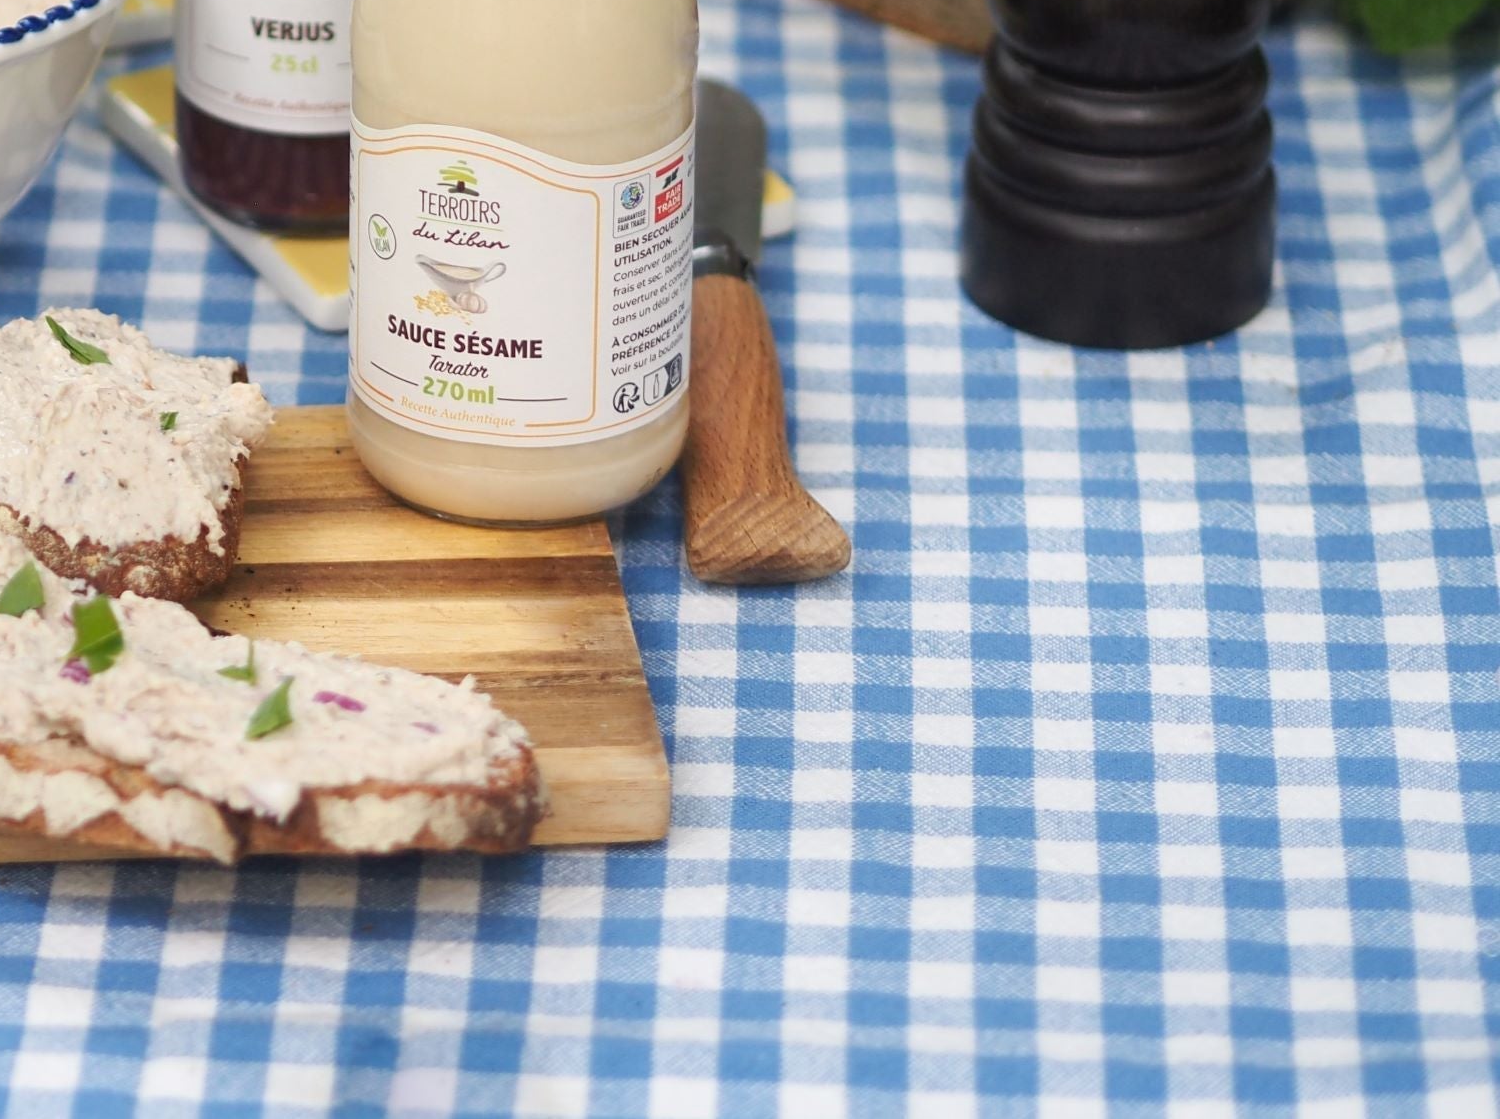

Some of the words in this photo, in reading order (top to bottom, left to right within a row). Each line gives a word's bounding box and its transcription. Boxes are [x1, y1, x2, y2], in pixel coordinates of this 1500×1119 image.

[250, 16, 336, 42] VERJUS
[418, 189, 501, 225] TERROIRS
[656, 193, 682, 215] TRADE
[665, 183, 682, 201] FAIR
[412, 221, 440, 241] du
[444, 229, 510, 250] Liban
[614, 238, 639, 253] BIEN
[641, 217, 679, 244] SECOUER
[617, 223, 630, 233] FAIR
[630, 217, 646, 230] TRADE
[613, 258, 660, 282] Conserver
[661, 247, 678, 264] dans
[614, 236, 672, 267] UTILISATION.
[612, 289, 659, 312] ouverture
[660, 282, 668, 293] et
[613, 284, 635, 297] frais
[636, 279, 646, 288] et
[612, 313, 637, 326] dans
[639, 307, 651, 318] un
[652, 295, 670, 312] délai
[388, 314, 446, 350] SAUCE
[453, 331, 543, 359] SÉSAME
[612, 335, 620, 349] À
[622, 307, 678, 345] CONSOMMER
[611, 328, 671, 363] PRÉFÉRENCE
[428, 354, 489, 379] Tarator
[611, 362, 631, 377] Voir
[633, 357, 648, 369] sur
[649, 353, 657, 363] la
[400, 395, 438, 417] Recette
[440, 408, 517, 428] Authentique
